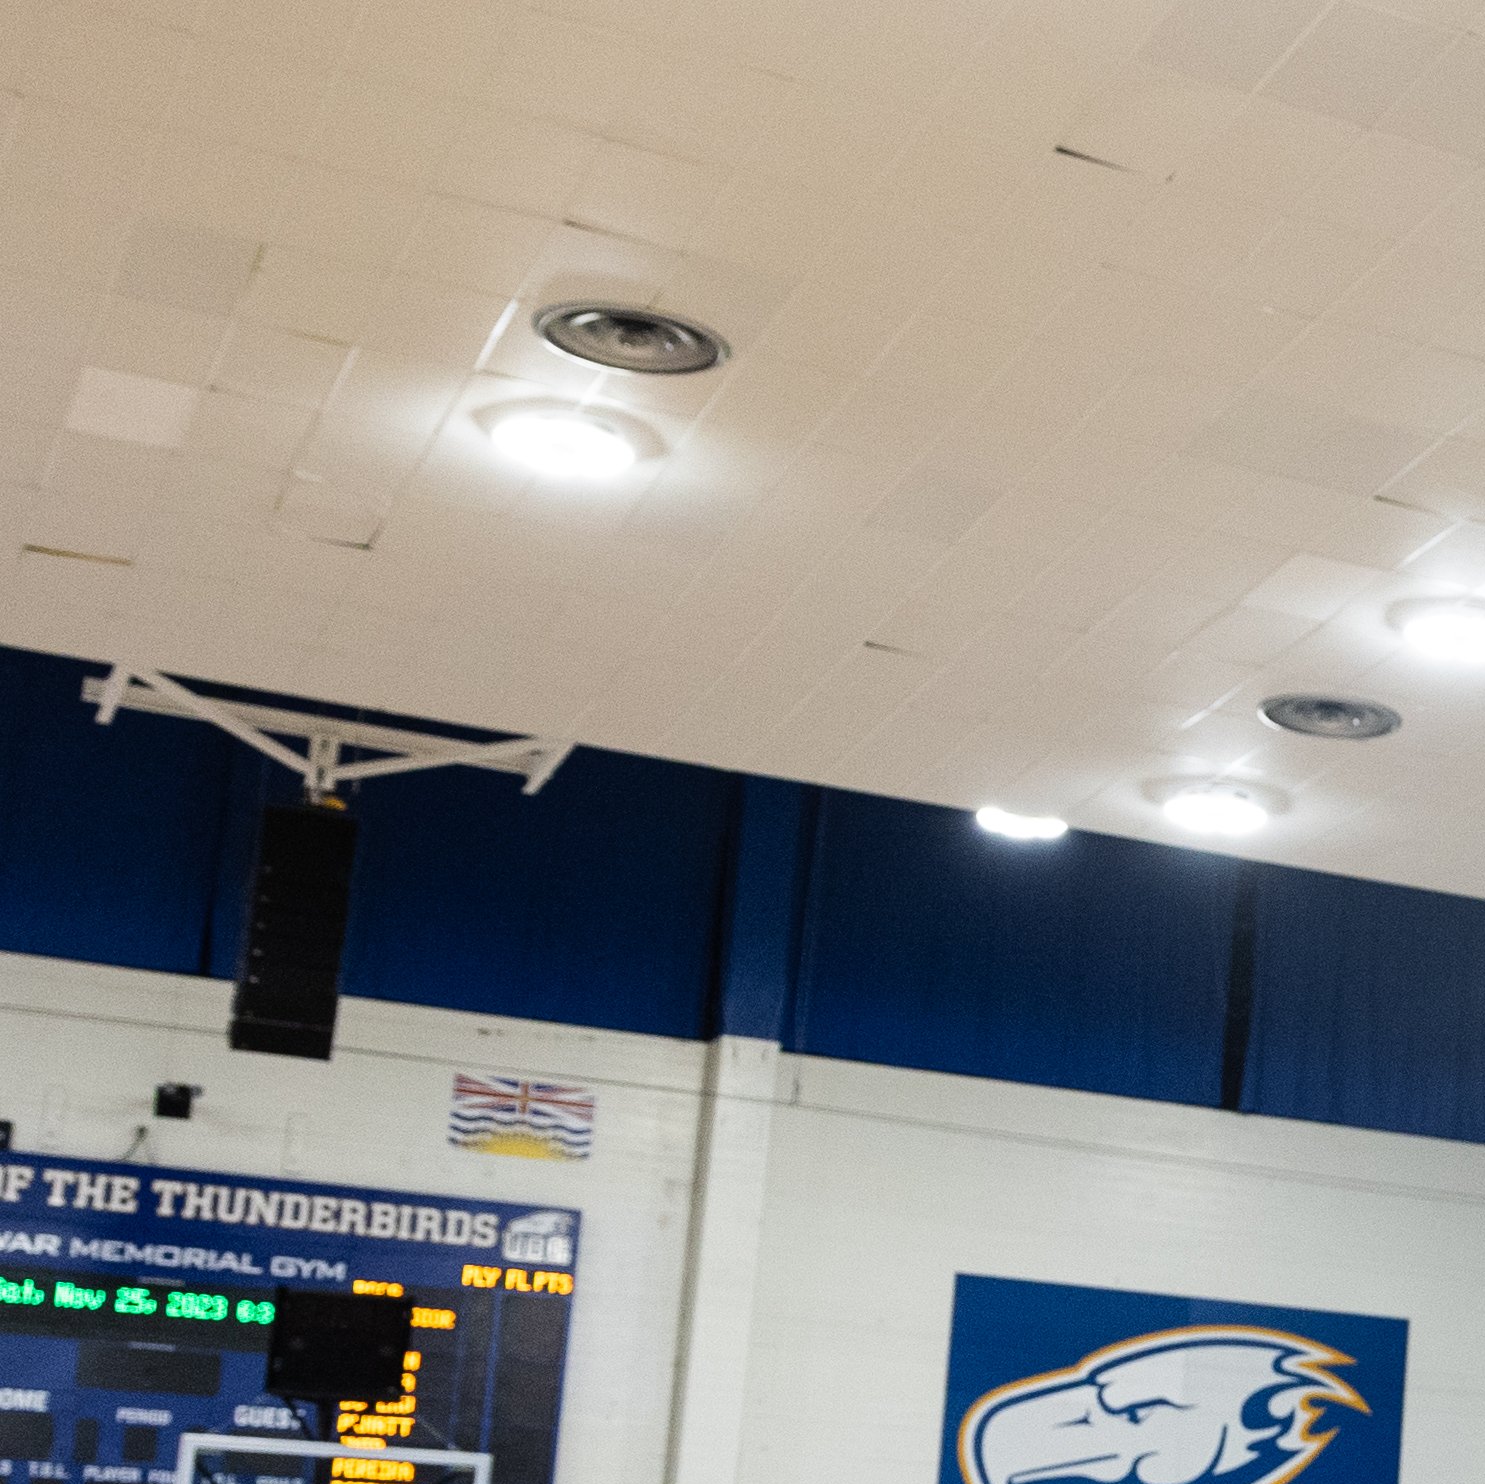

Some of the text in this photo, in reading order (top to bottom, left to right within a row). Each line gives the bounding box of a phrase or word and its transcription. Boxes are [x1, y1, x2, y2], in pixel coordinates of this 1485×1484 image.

[43, 1168, 141, 1214] THE
[152, 1179, 500, 1249] THUNDERBIRDS
[70, 1237, 264, 1275] MEMORIAL
[269, 1254, 349, 1283] GYM
